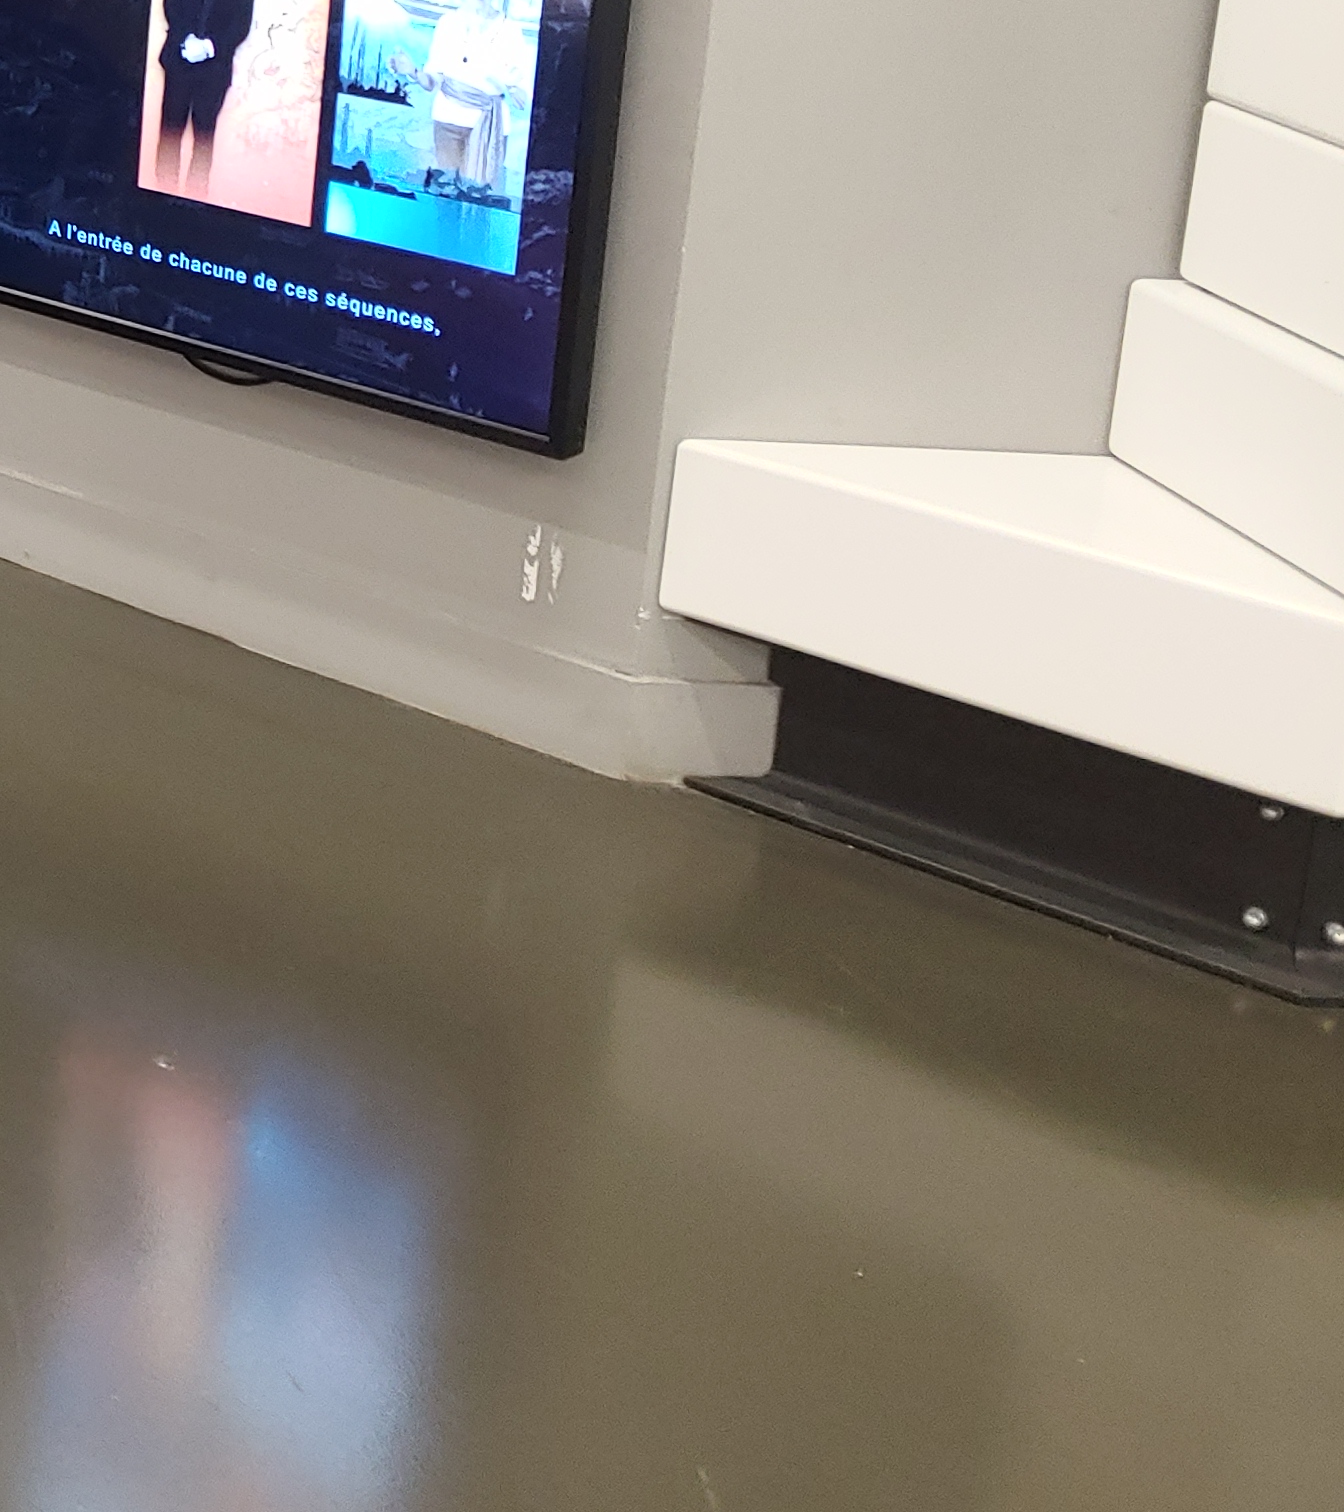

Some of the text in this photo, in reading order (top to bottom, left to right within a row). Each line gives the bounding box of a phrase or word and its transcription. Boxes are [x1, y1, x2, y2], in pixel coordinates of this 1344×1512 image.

[49, 219, 442, 336] A l'entrée de chacune de ces séquences,
